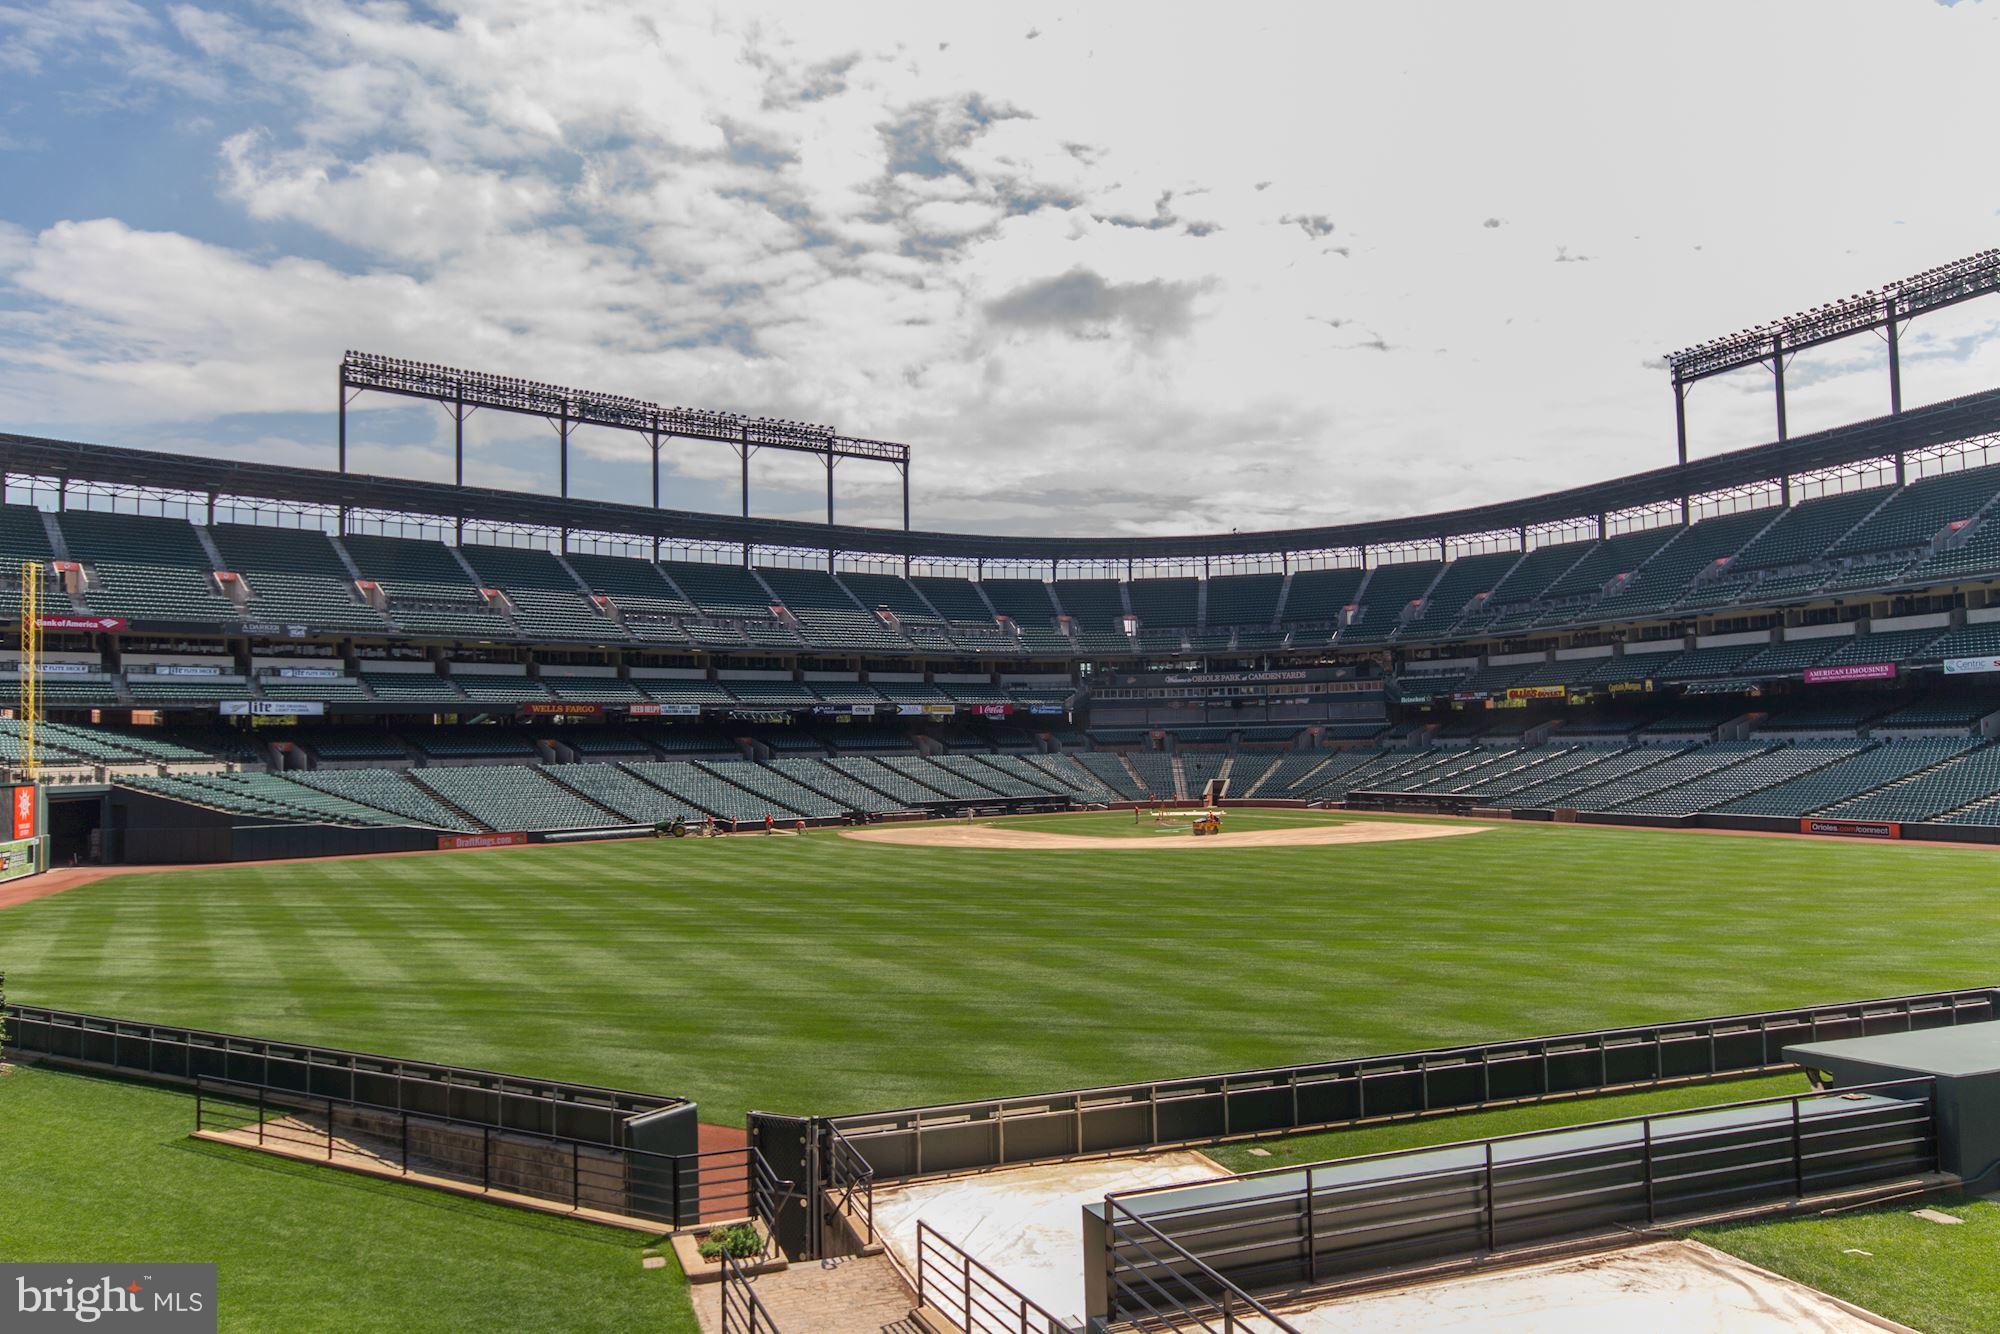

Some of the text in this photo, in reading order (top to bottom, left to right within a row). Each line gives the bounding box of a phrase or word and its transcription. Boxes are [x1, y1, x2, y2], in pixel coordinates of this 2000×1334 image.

[36, 619, 56, 627] Bank
[66, 620, 98, 628] America
[1956, 660, 1985, 669] Centric
[1192, 675, 1220, 683] ORIOLE
[1221, 674, 1240, 682] PARK
[1282, 671, 1306, 679] YARDS
[1809, 669, 1844, 678] AMERICAN
[1845, 666, 1889, 675] LIMOUSINES
[532, 705, 595, 713] WELLS FARGO
[1811, 823, 1889, 835] Orioles.com/connect
[456, 837, 512, 848] DraftKings.com
